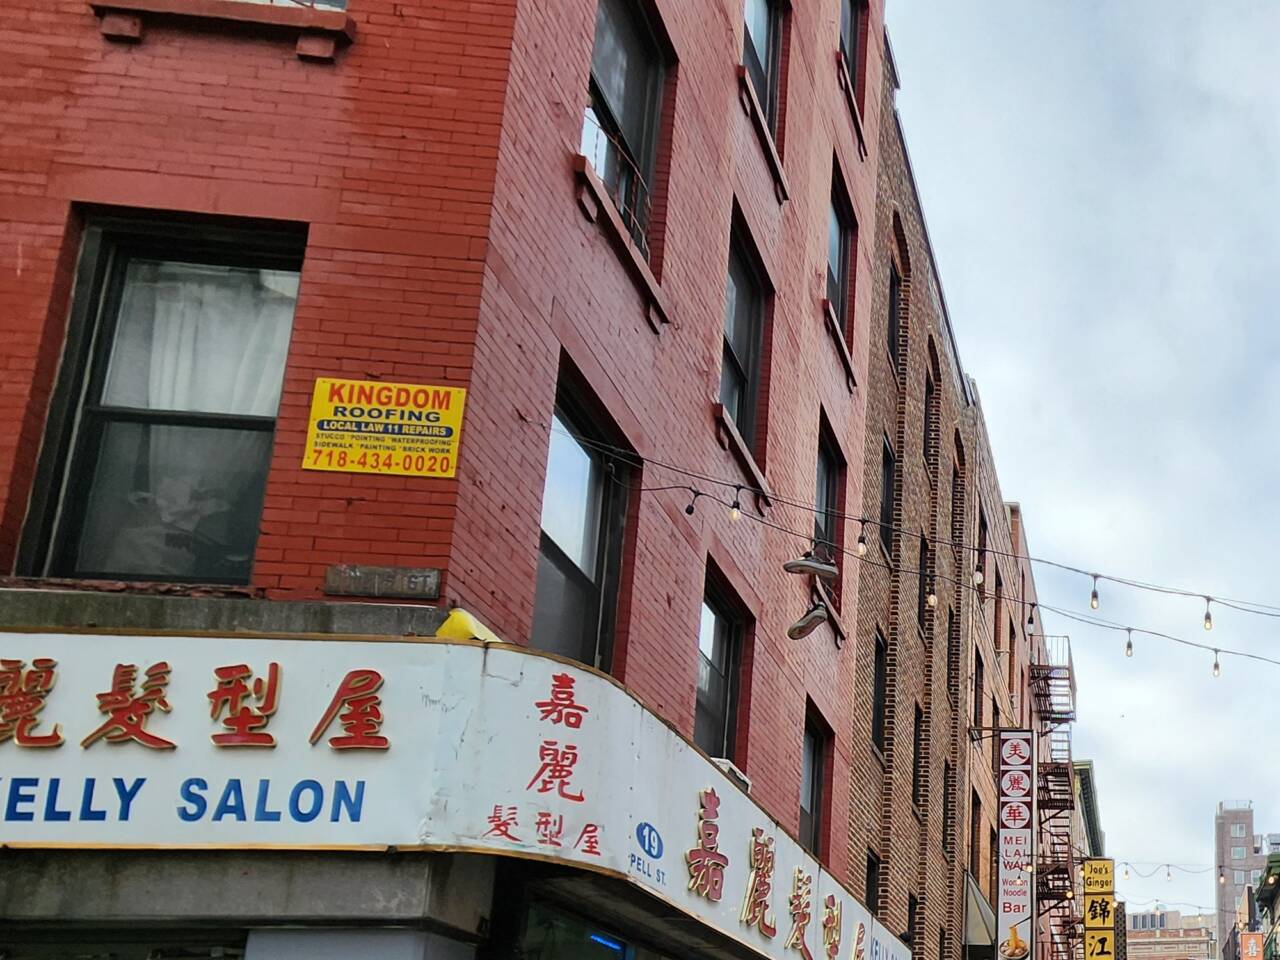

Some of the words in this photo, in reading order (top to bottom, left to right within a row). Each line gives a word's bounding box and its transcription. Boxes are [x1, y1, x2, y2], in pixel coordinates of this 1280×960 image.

[328, 383, 451, 410] KINGDOM
[333, 406, 441, 422] ROOFING
[323, 420, 357, 430] LOCAL
[361, 423, 384, 432] LAW
[387, 425, 398, 433] 11
[402, 426, 446, 436] REPAIRS
[314, 441, 353, 449] SIDEWALK
[312, 448, 450, 473] 718-434-0020
[526, 672, 589, 802] 嘉麗
[1005, 741, 1028, 827] 美麗華
[0, 776, 146, 822] ELLY
[176, 778, 367, 823] SALON
[481, 804, 602, 858] 髮型屋
[641, 827, 660, 855] 19
[1003, 836, 1027, 845] MEI
[1005, 849, 1027, 858] LAI
[629, 853, 652, 880] PELL
[655, 869, 668, 886] ST.
[1003, 861, 1028, 870] WAH
[1089, 864, 1109, 874] Joe's
[1002, 878, 1028, 887] Wonon
[1086, 877, 1113, 888] Ginger
[1003, 888, 1027, 897] Noodle
[1002, 902, 1027, 913] Bar
